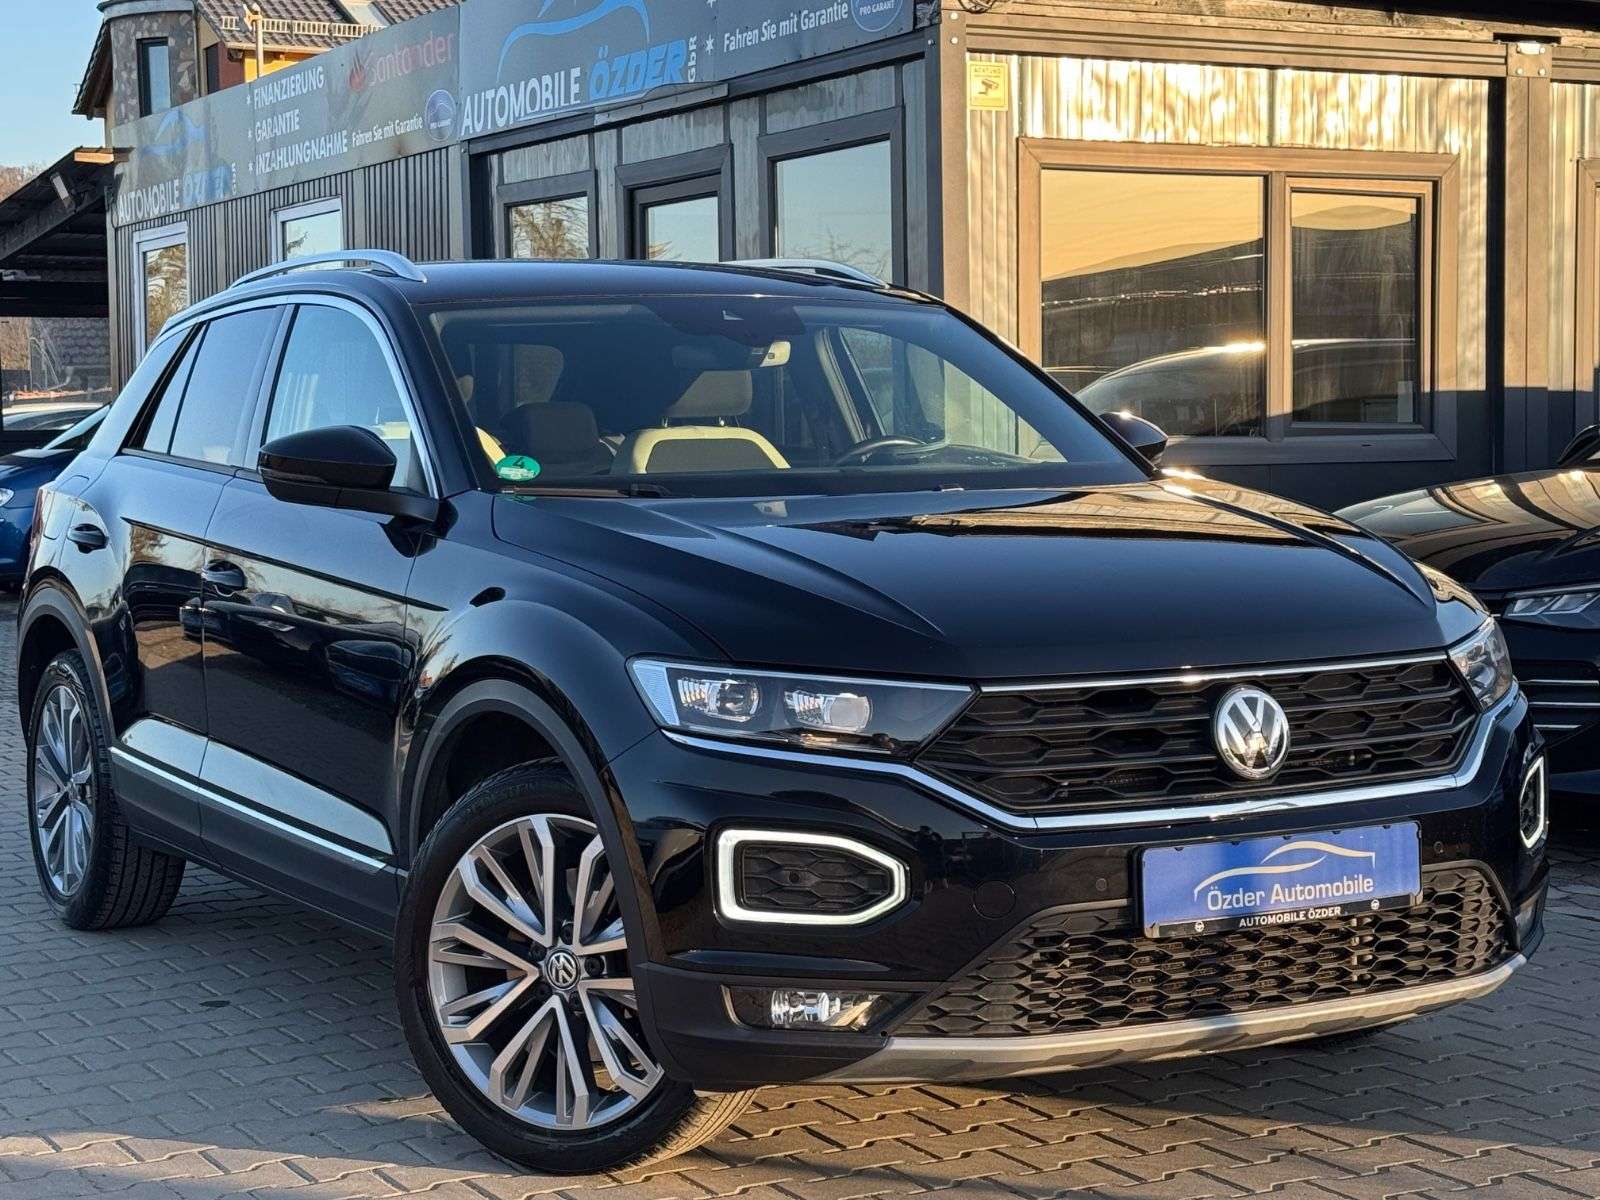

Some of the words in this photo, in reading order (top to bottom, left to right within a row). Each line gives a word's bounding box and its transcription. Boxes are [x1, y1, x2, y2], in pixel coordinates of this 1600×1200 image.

[723, 31, 760, 53] Fahren
[761, 20, 778, 43] Sie
[779, 16, 799, 37] mit
[801, 1, 849, 31] Garantie
[860, 6, 872, 16] PRO
[253, 66, 325, 110] FINANZIERUNG
[461, 67, 581, 136] AUTOMOBILE
[589, 39, 687, 100] ÖZDER
[254, 109, 300, 143] GARANTIE
[255, 130, 348, 175] INZAHLUNGNAHME
[118, 179, 180, 223] AUTOMOBILE
[512, 456, 526, 469] 4
[1207, 886, 1266, 911] Özder
[1270, 874, 1374, 904] Automobile
[1239, 911, 1306, 928] AUTOMOBILE
[1308, 906, 1342, 921] ÖZDER
